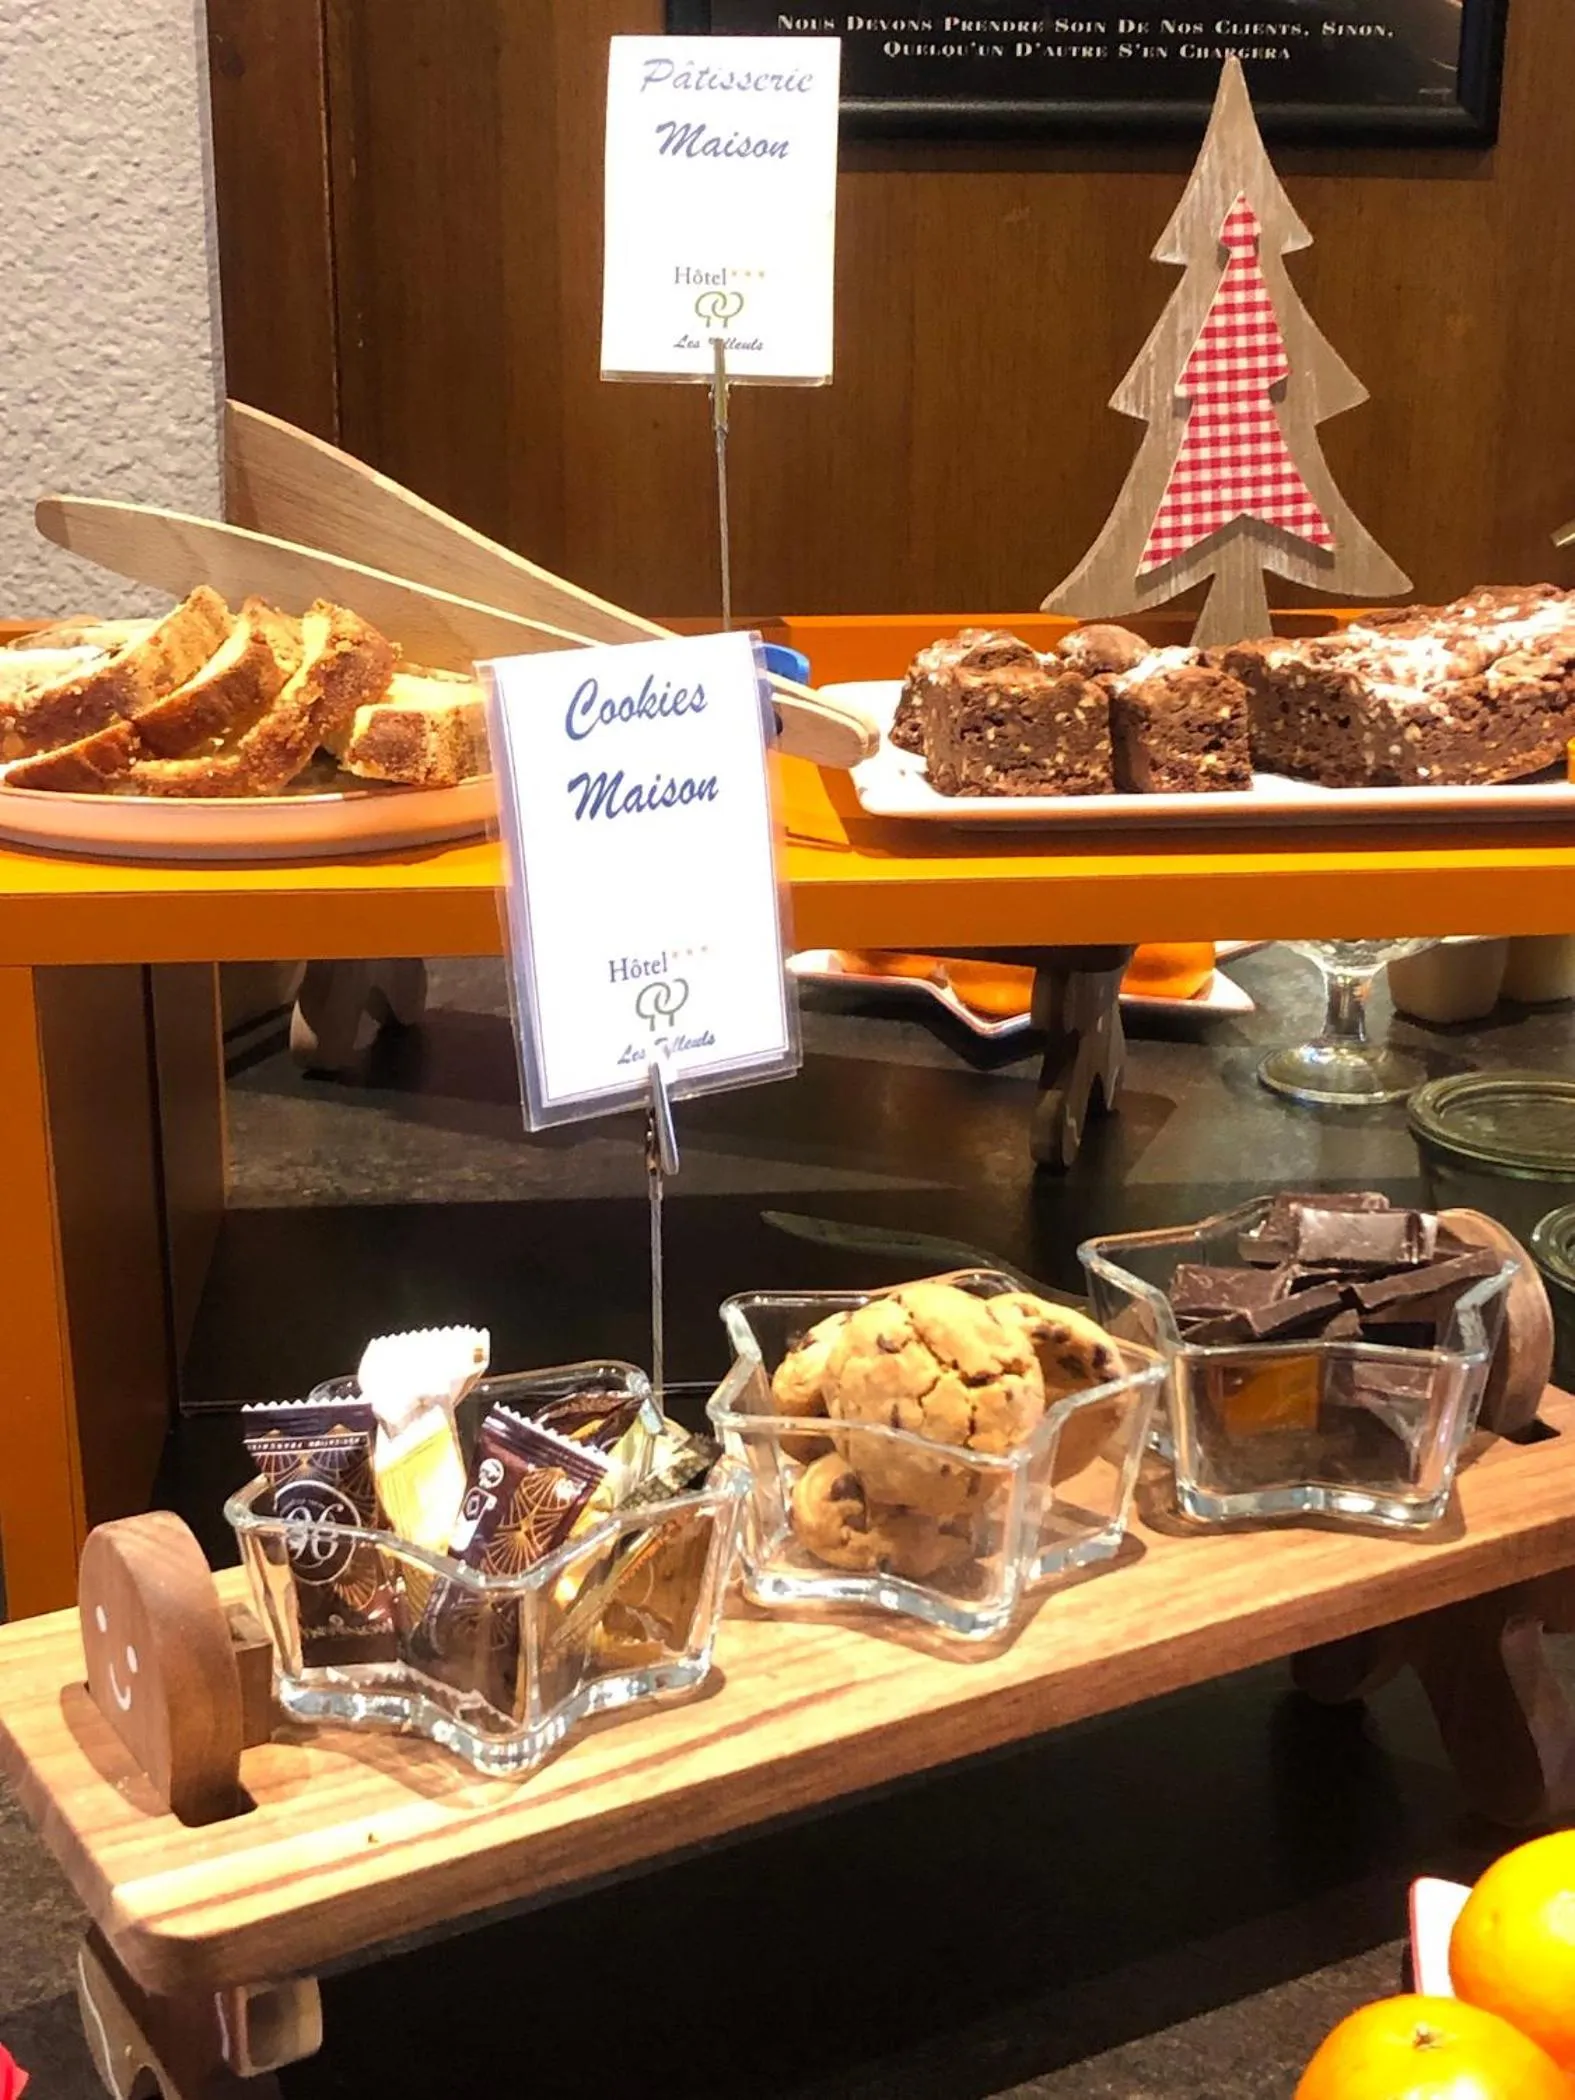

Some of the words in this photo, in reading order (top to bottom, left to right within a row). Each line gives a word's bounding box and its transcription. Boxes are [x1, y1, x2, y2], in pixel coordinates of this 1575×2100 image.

[640, 57, 815, 93] Pâtisserie
[655, 120, 790, 160] Maison
[674, 265, 727, 286] Hôtel
[672, 333, 701, 350] Les
[564, 673, 708, 742] Cookies
[567, 769, 719, 822] Maison
[608, 951, 669, 984] Hôtel
[616, 1043, 647, 1065] Les
